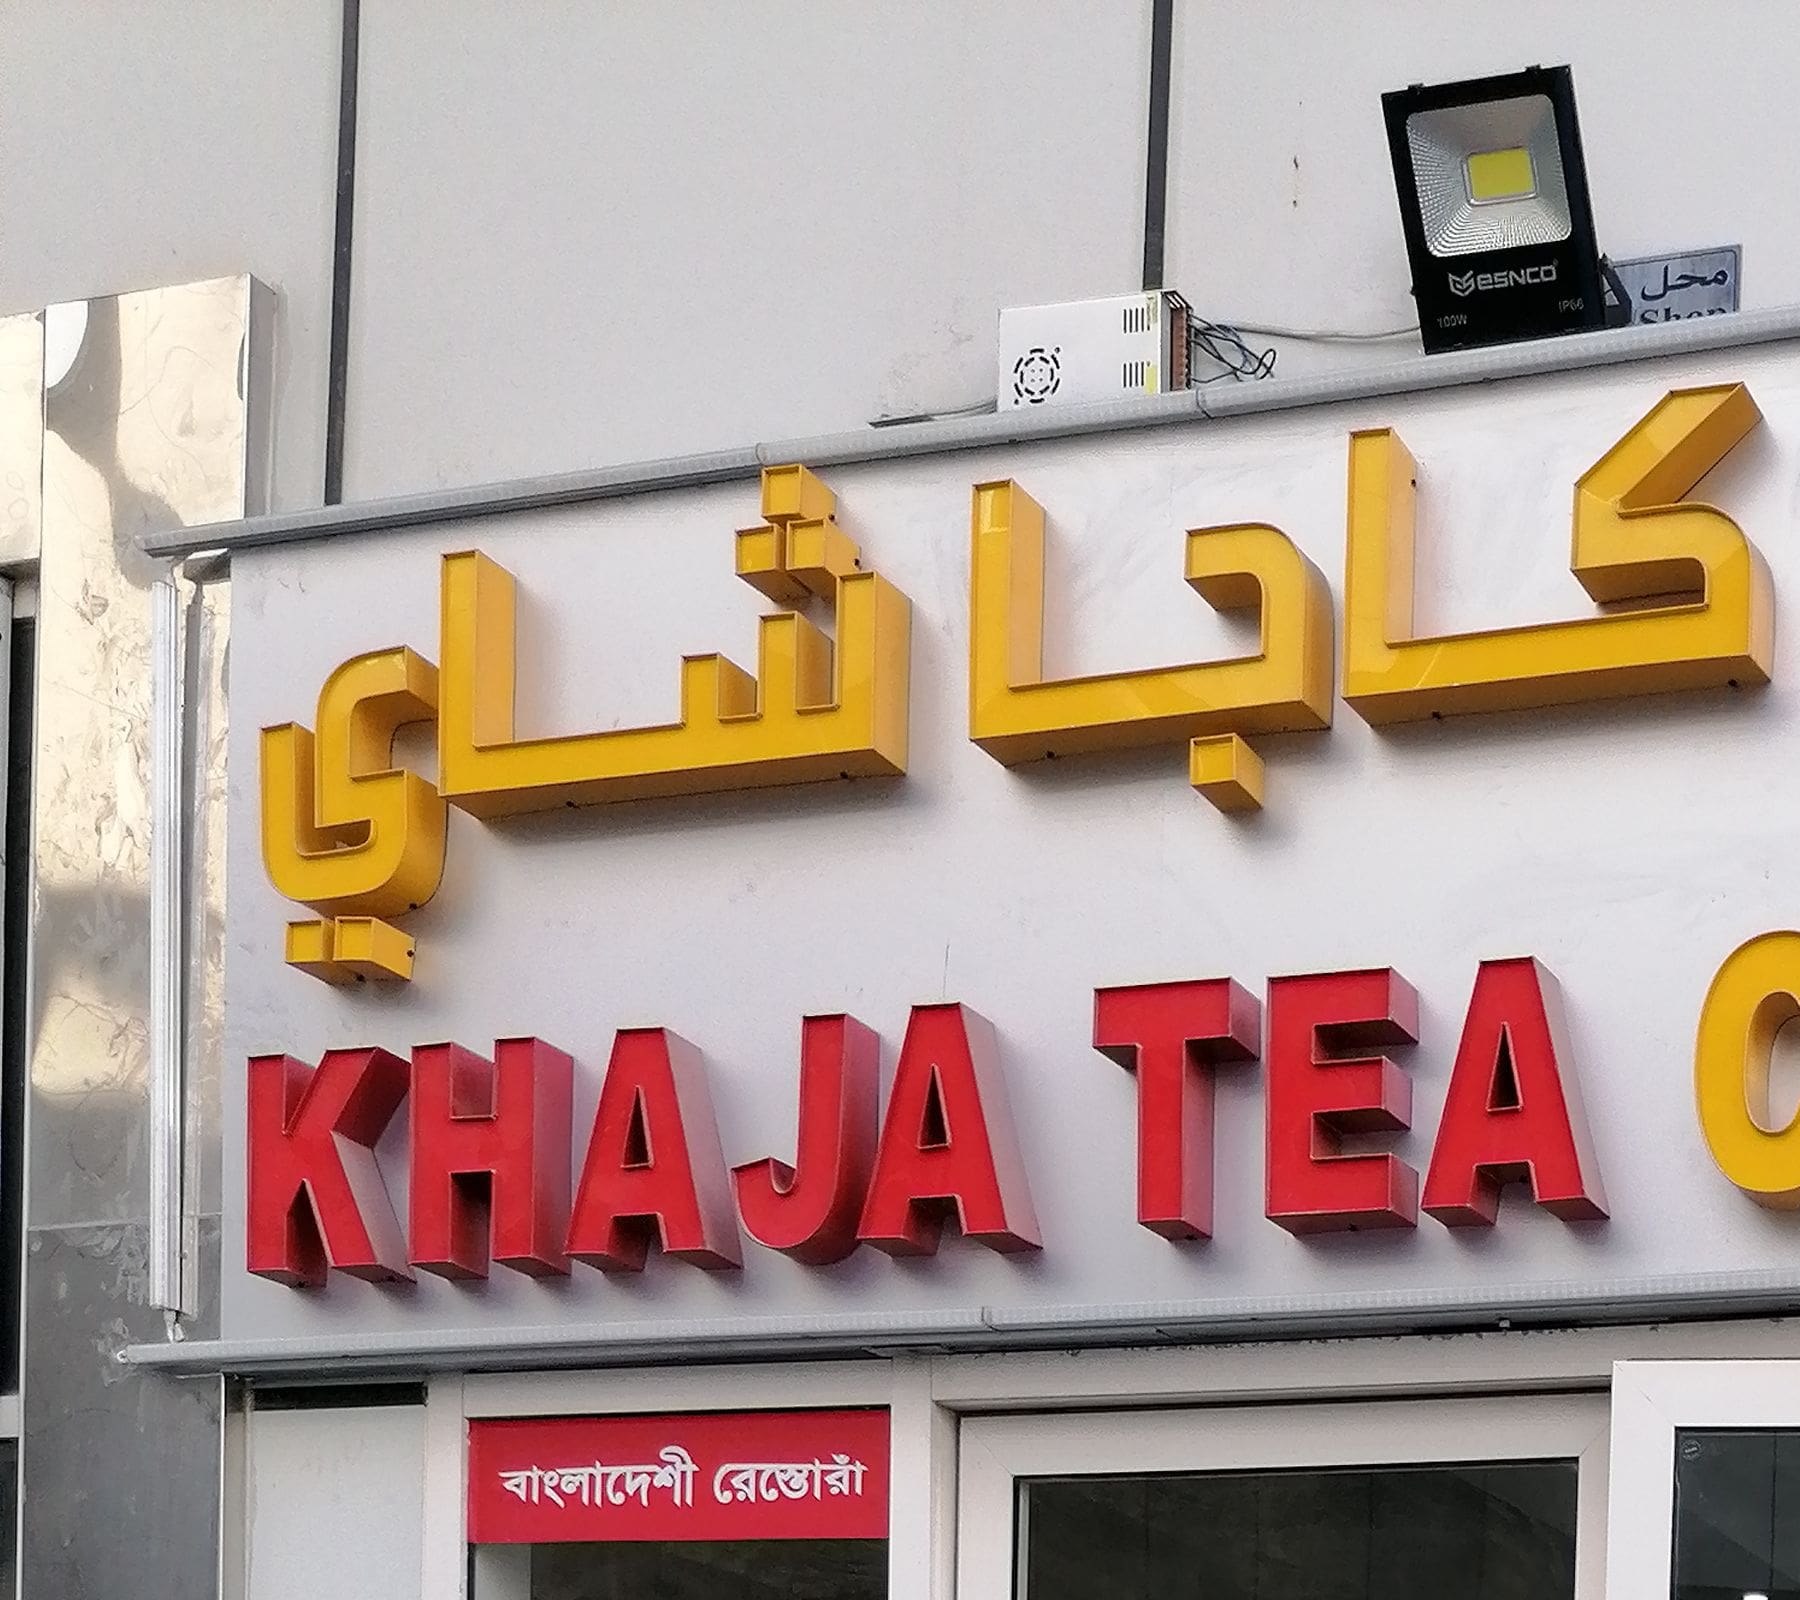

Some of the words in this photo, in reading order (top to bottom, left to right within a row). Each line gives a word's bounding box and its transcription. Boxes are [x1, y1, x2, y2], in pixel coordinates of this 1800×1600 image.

[1641, 264, 1728, 301] محل
[260, 464, 911, 987] شاي
[247, 1003, 1041, 1287] KHAJA
[1093, 957, 1607, 1240] TEA
[498, 1446, 699, 1508] বাংলাদেশী
